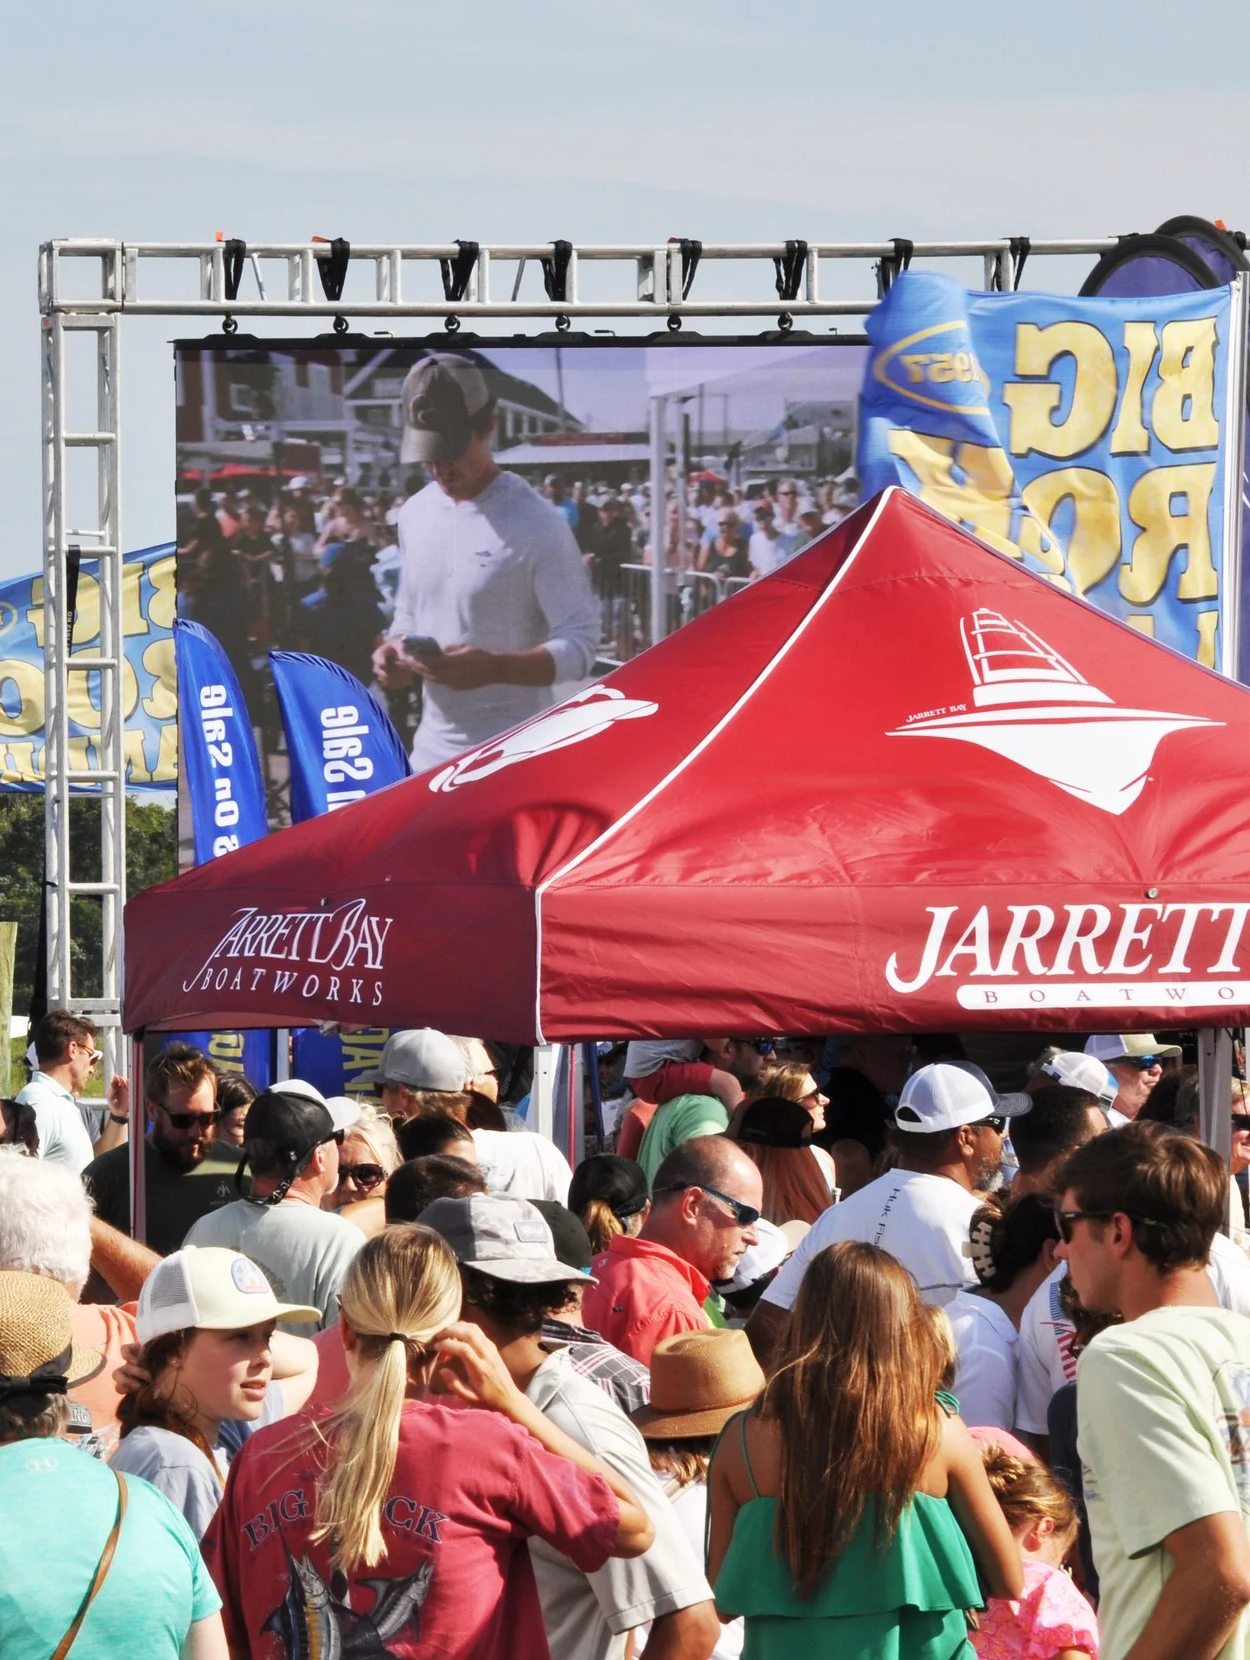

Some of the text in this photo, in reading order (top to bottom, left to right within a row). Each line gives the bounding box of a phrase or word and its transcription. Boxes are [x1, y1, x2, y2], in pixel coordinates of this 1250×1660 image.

[905, 703, 967, 723] JARRETT BAY
[183, 898, 394, 992] JARRETT BAY
[201, 967, 384, 1006] BOATWORKS
[984, 986, 1235, 1004] BOATWO
[241, 1489, 450, 1551] BIG CK
